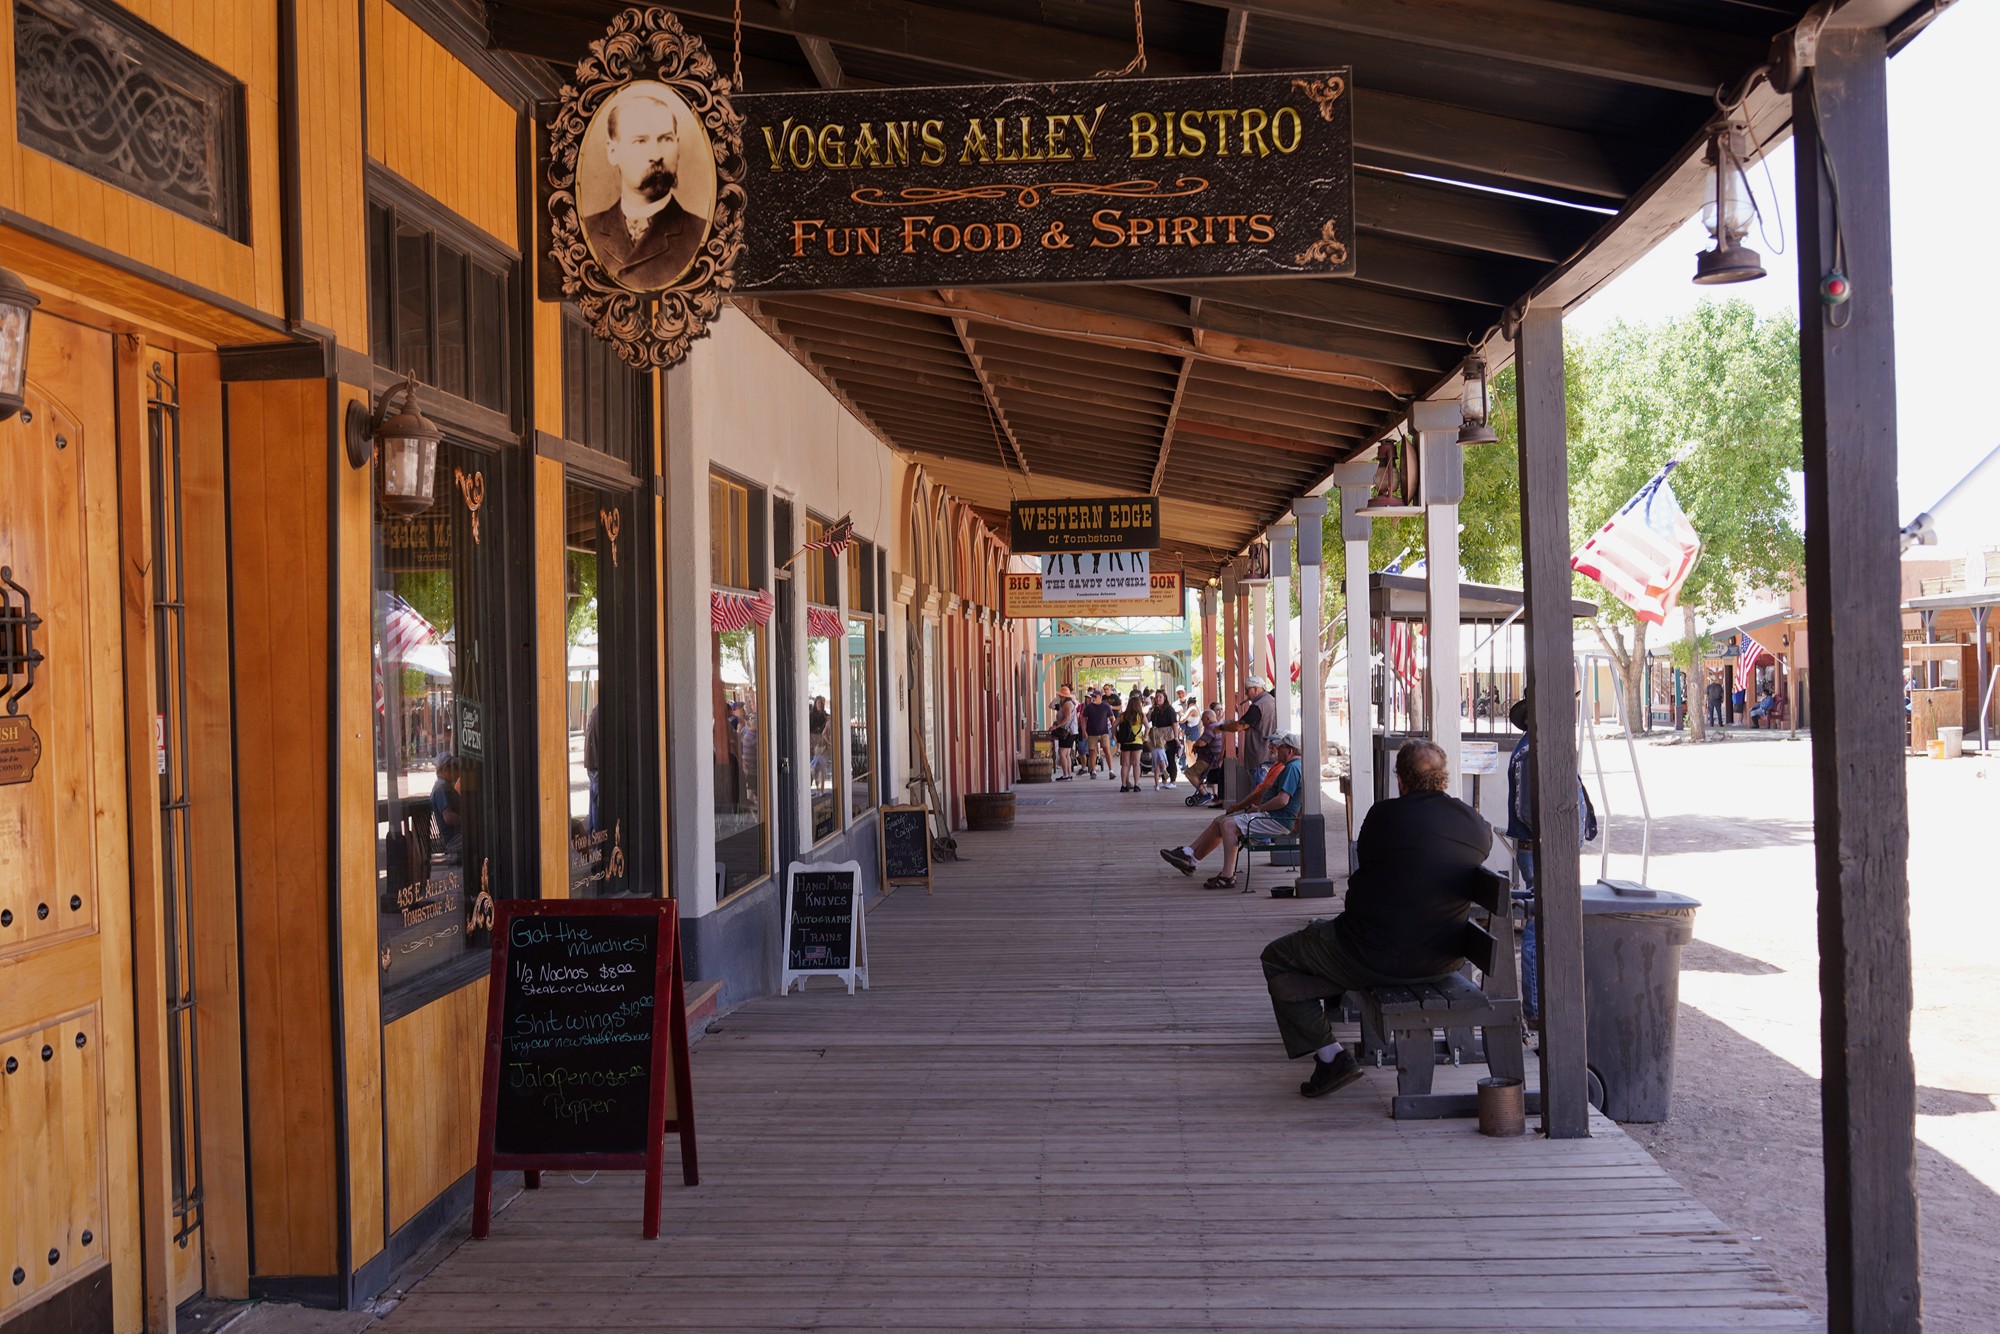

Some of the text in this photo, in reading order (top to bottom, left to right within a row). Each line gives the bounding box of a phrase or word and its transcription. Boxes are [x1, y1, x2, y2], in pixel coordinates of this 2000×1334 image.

[760, 102, 1303, 173] VOGAN'S ALLEY BISTRO
[789, 208, 1277, 258] FUN FOOD & SPIRITS
[1018, 503, 1152, 531] WESTERN EDGE
[1048, 533, 1123, 544] Of Tombstone
[1009, 577, 1030, 590] BIG
[1045, 579, 1065, 589] THE
[1068, 578, 1103, 589] GAWDY
[1106, 577, 1146, 587] COWGIRL
[1150, 575, 1176, 589] OON
[462, 727, 481, 750] OPEN
[397, 872, 460, 908] 435 E. ALLEN ST.
[805, 891, 847, 907] KNIVES
[401, 901, 443, 929] TOMBSTONE
[791, 910, 852, 925] AUTOGRAPHS
[510, 918, 593, 948] Got the
[798, 928, 842, 943] TRAINS
[824, 947, 848, 966] ART
[516, 961, 534, 983] 1/2
[539, 963, 589, 983] Nachos
[521, 984, 559, 996] Steak
[560, 985, 577, 994] or
[515, 1009, 564, 1038] Shit
[565, 1010, 626, 1042] wings
[530, 1037, 554, 1049] our
[554, 1035, 582, 1048] new
[509, 1062, 605, 1096] Jalapeno
[542, 1093, 617, 1124] Popper
